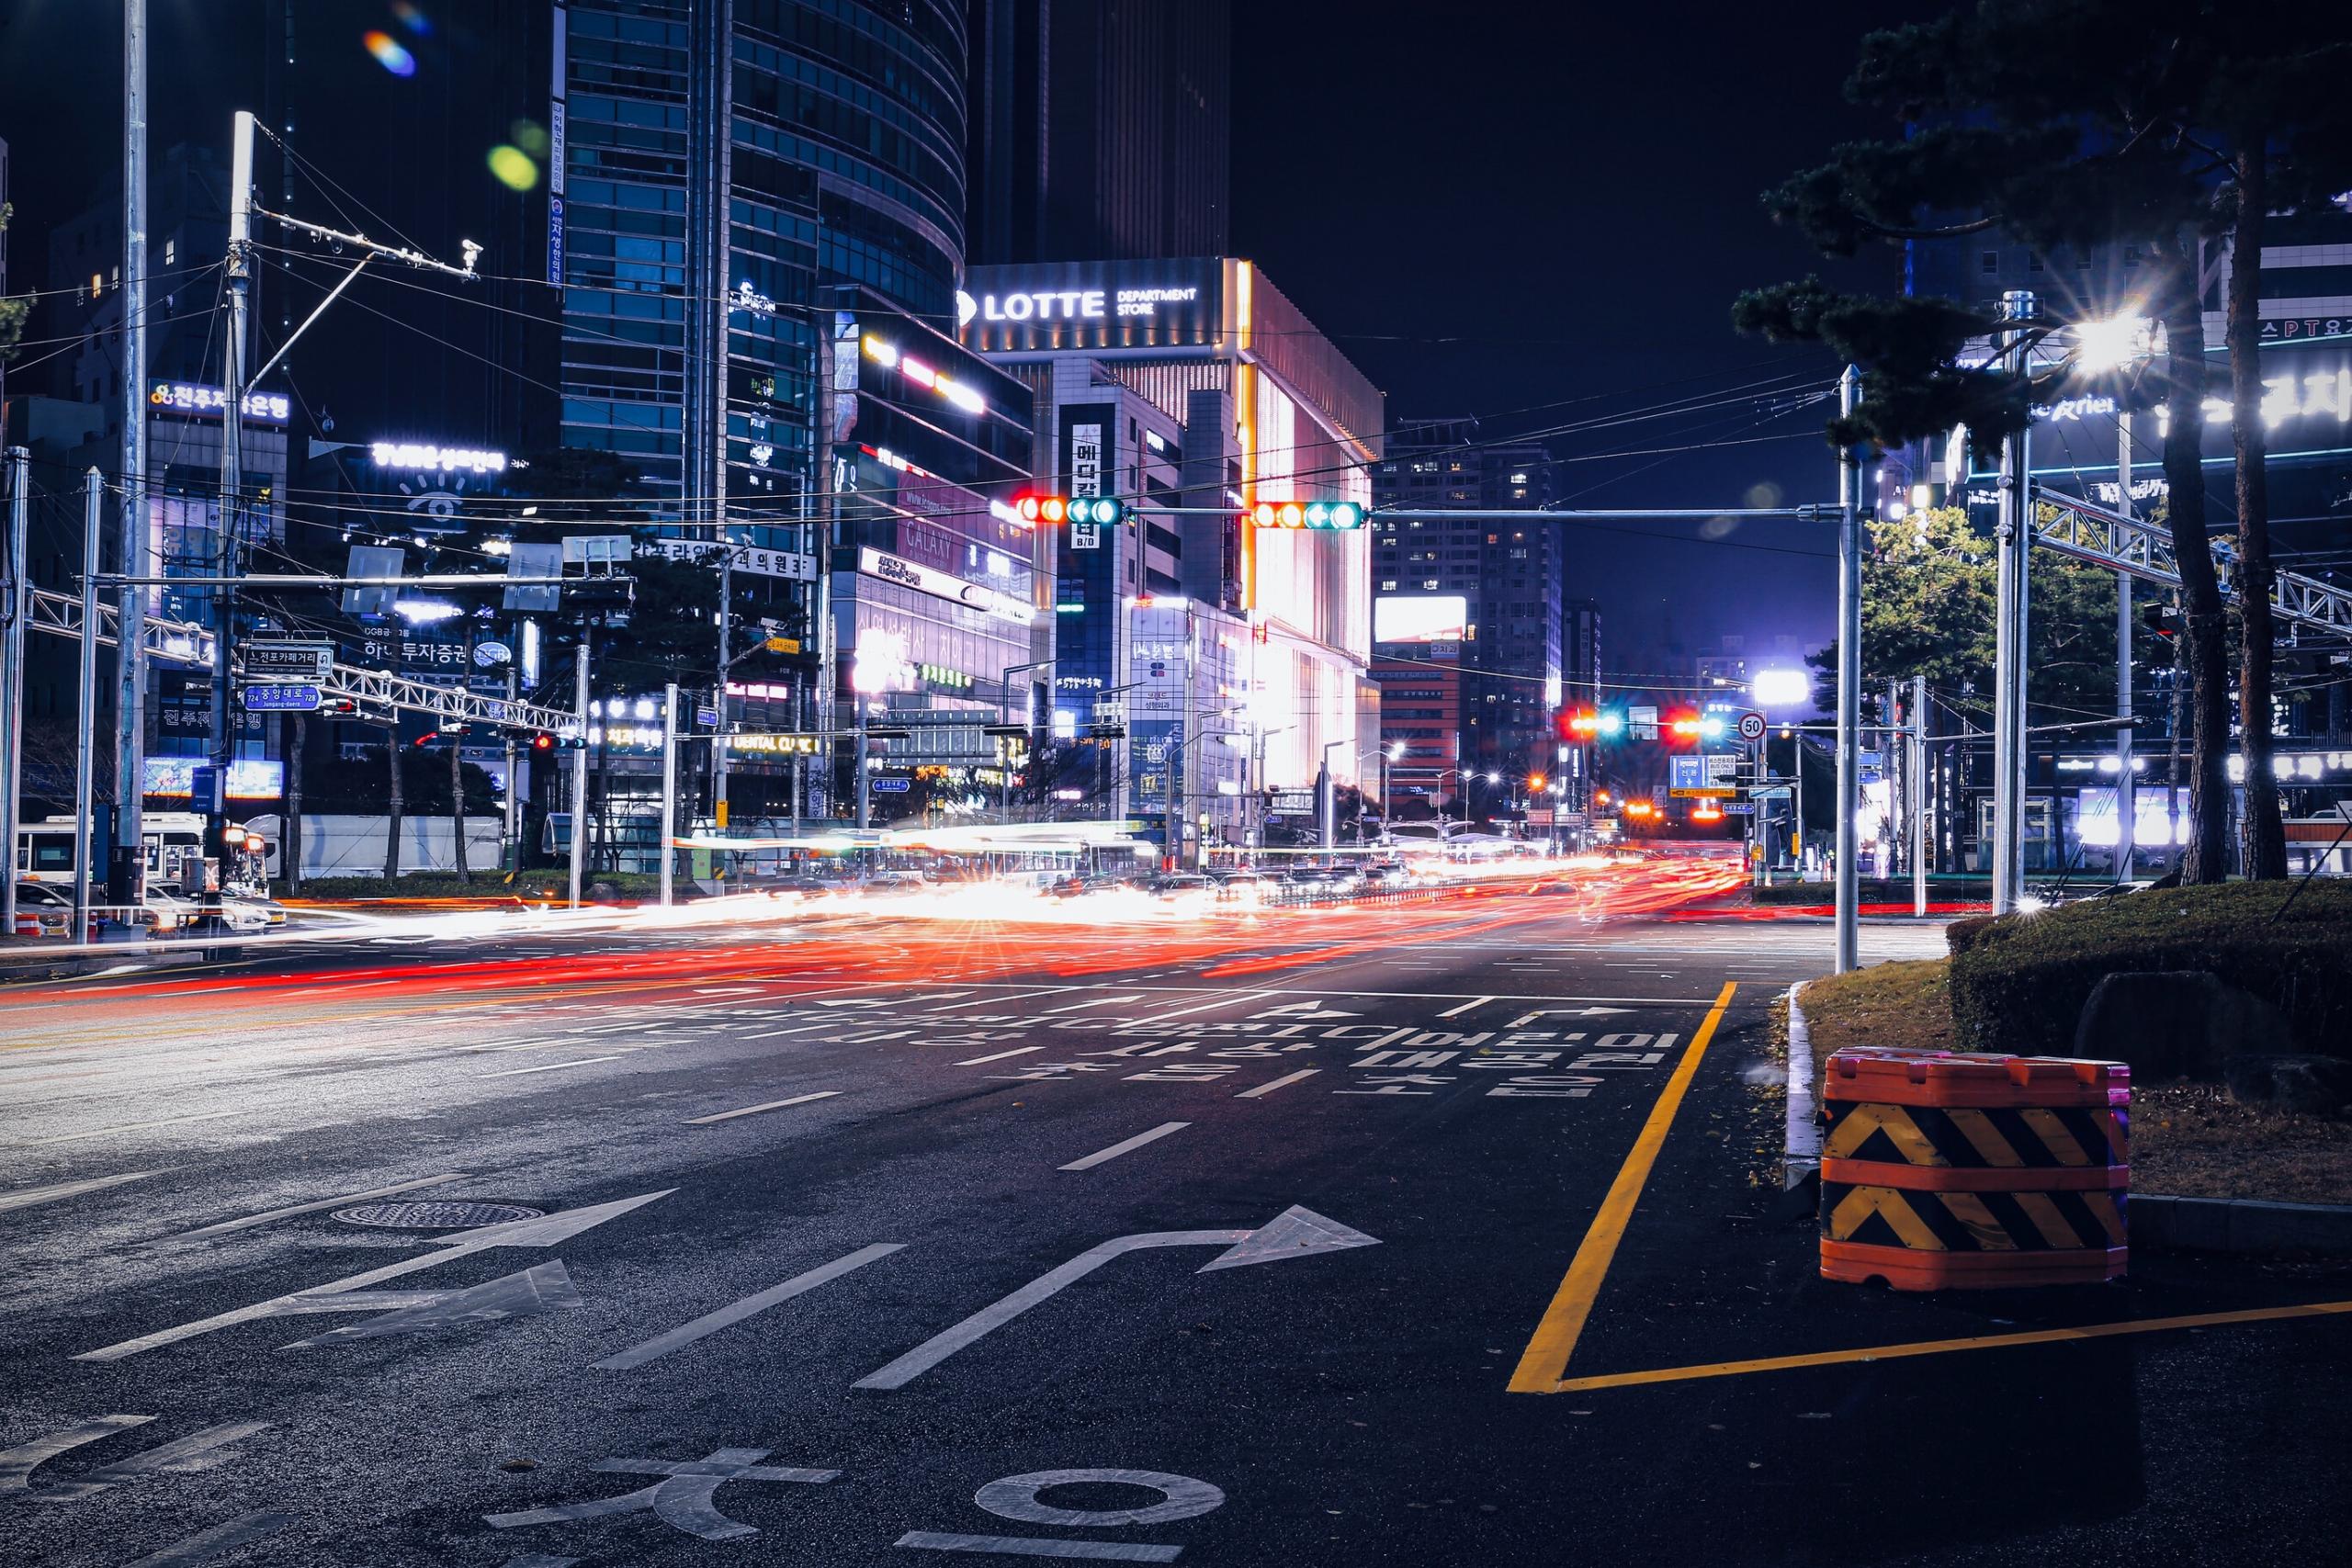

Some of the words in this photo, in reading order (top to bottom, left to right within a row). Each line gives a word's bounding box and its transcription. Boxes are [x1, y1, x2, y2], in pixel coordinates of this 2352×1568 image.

[985, 291, 1105, 321] LOTTE
[1117, 288, 1197, 302] DEPARTMENT
[1117, 302, 1155, 316] STORE
[906, 521, 953, 559] GALAXY
[1077, 537, 1094, 547] B/D
[260, 651, 316, 663] 전포카페거리
[262, 688, 302, 700] 중앙대로
[305, 694, 316, 702] 728
[164, 709, 262, 729] 진주저은행
[1746, 720, 1759, 732] 50
[1075, 1041, 1319, 1058] 사상
[1349, 1050, 1665, 1070] 대공원
